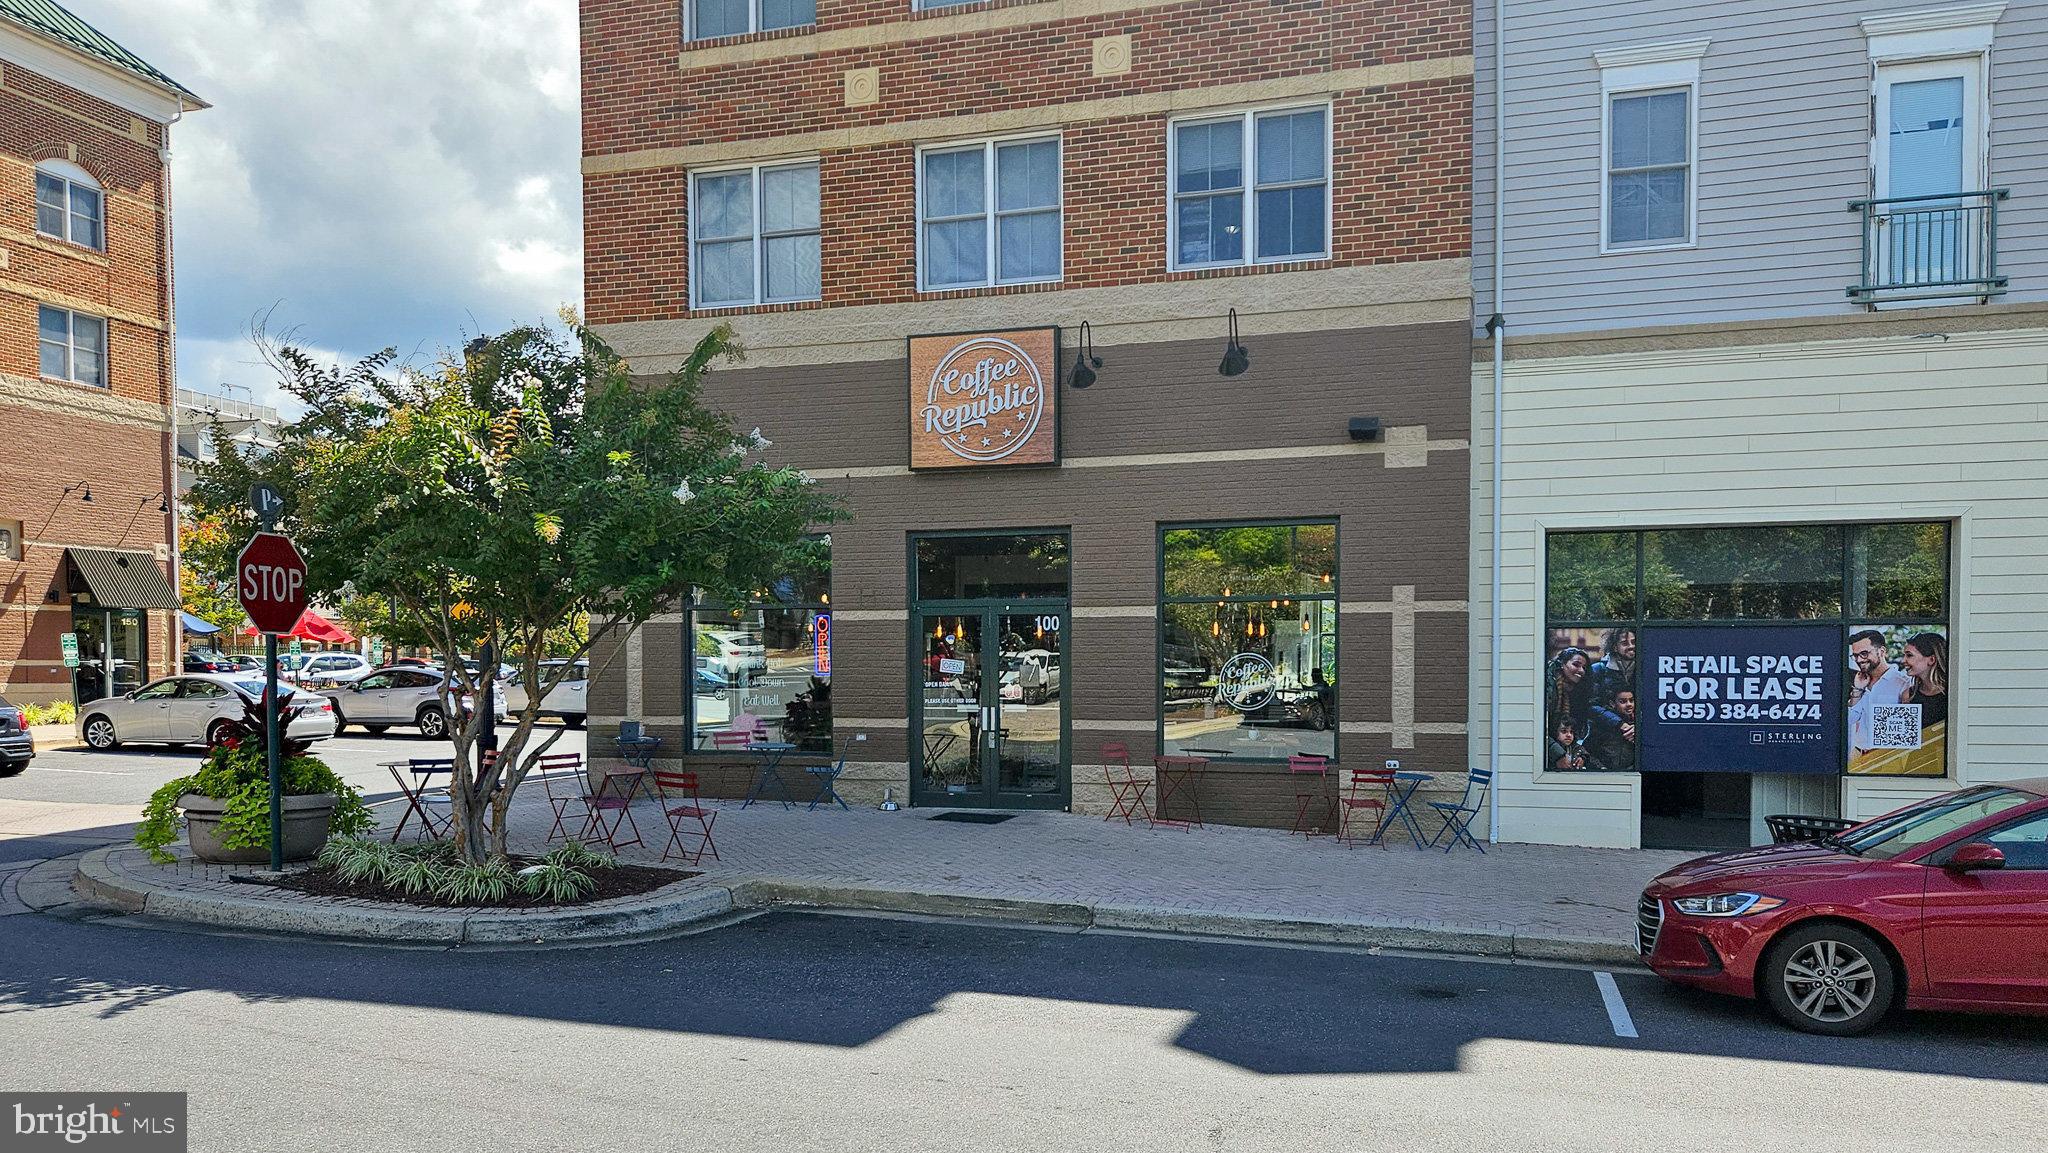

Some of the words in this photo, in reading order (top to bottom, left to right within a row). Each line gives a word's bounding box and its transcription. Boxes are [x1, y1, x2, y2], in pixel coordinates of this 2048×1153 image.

[939, 355, 1021, 398] Coffee
[920, 382, 1038, 435] Republic
[261, 488, 271, 511] P
[243, 563, 303, 603] STOP
[121, 618, 139, 626] 150
[1035, 615, 1060, 631] 100
[817, 618, 829, 673] OPEN
[1225, 662, 1265, 681] Coffee
[1658, 656, 1741, 674] RETAIL
[1746, 655, 1824, 674] SPACE
[1216, 674, 1275, 699] Republic
[1658, 676, 1719, 700] FOR
[1726, 676, 1823, 700] LEASE
[743, 694, 760, 707] Eat
[761, 694, 781, 706] Well
[1658, 702, 1716, 720] (855)
[1720, 703, 1822, 720] 384-6474
[1768, 732, 1822, 740] STERLING
